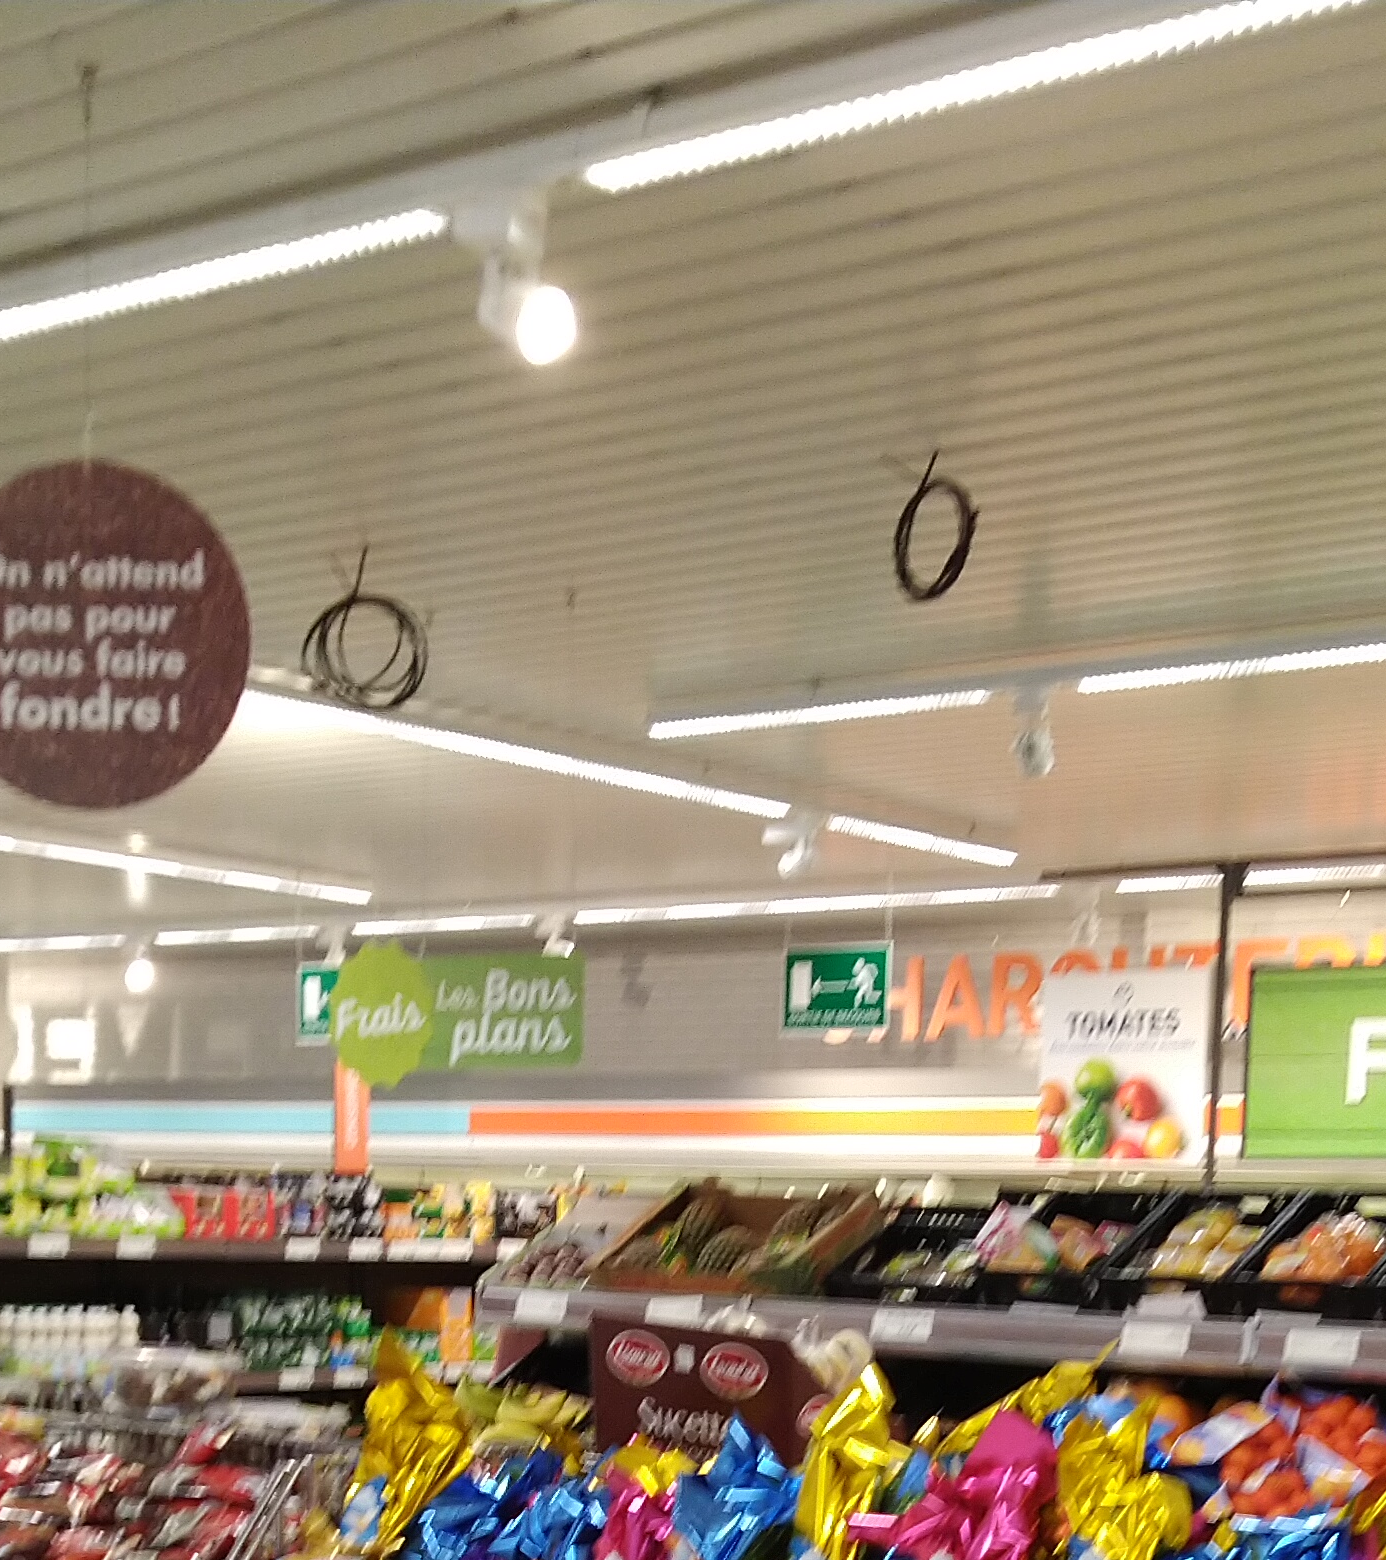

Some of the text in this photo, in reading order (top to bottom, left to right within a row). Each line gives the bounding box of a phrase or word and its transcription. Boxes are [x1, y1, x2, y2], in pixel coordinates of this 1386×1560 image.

[42, 546, 206, 591] n'attend
[4, 603, 177, 643] pas pour
[96, 638, 187, 681] faire
[435, 968, 578, 1013] Les Bons
[334, 991, 428, 1042] Frais
[448, 1003, 573, 1068] plans
[1065, 1007, 1181, 1040] TOMATES
